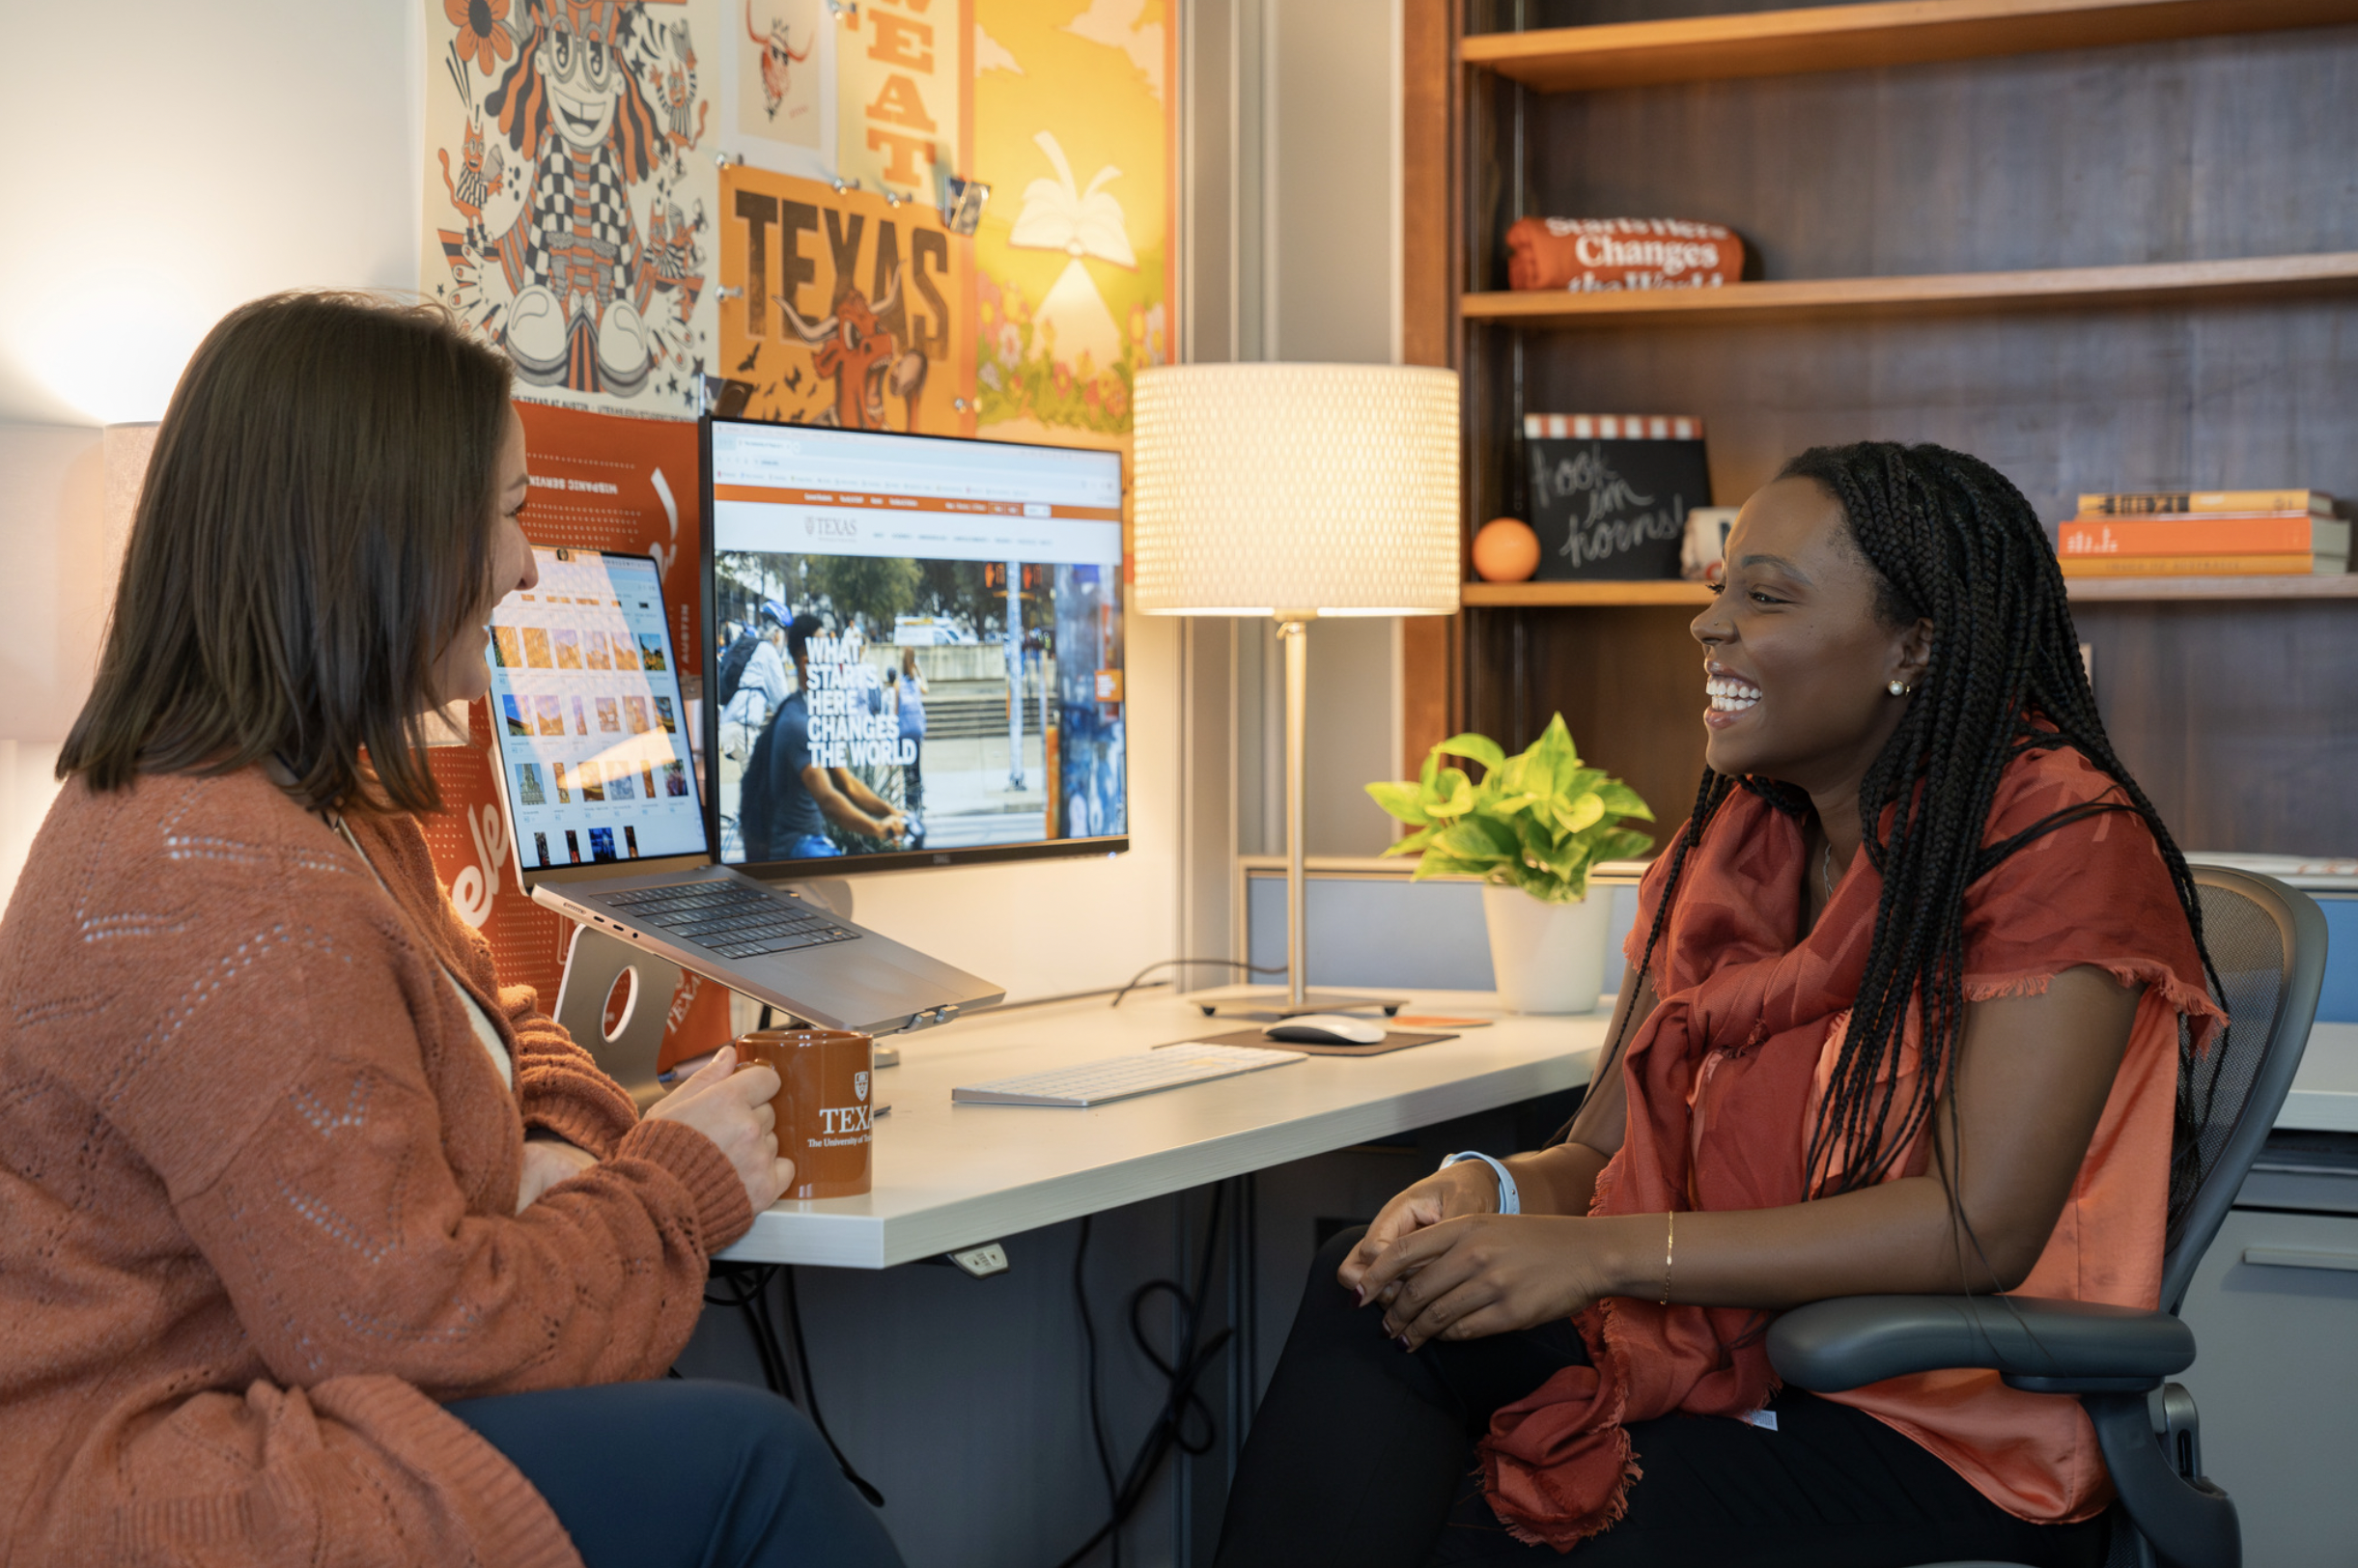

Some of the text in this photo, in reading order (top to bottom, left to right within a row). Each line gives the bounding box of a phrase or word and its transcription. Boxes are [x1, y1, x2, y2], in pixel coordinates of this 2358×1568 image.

[866, 0, 937, 188] EAT
[1575, 233, 1721, 276] Changes
[734, 188, 949, 363] TEXAS
[528, 474, 619, 495] HISPANIC SERVIN
[816, 517, 857, 536] TEXAS
[804, 636, 863, 665] WHAT
[805, 662, 880, 690] STARTS
[806, 688, 858, 716] HERE
[807, 713, 901, 742] CHANGES
[807, 738, 918, 769] THE WORLD
[665, 975, 702, 1034] TEXA
[819, 1106, 873, 1134] TEXA
[807, 1138, 823, 1148] The
[823, 1136, 857, 1147] University
